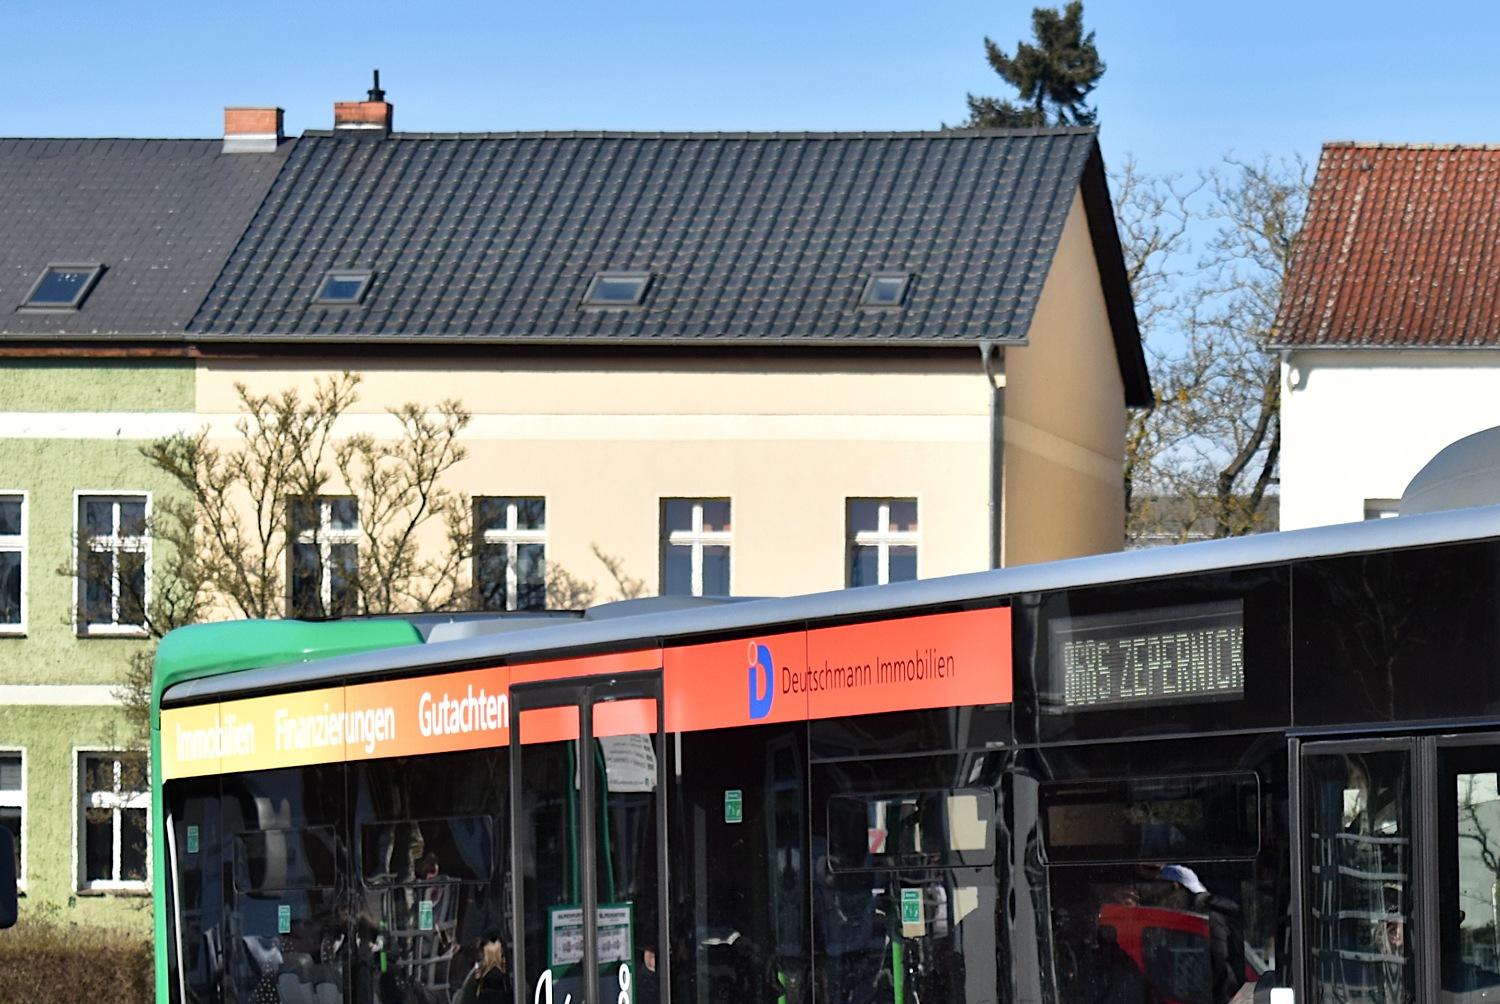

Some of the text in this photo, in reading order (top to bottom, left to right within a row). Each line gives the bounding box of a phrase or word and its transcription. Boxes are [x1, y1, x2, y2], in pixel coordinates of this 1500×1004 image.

[782, 648, 955, 694] Deutschmann Immobilien
[176, 684, 509, 761] Immobilien Finanzierungen Gutachten
